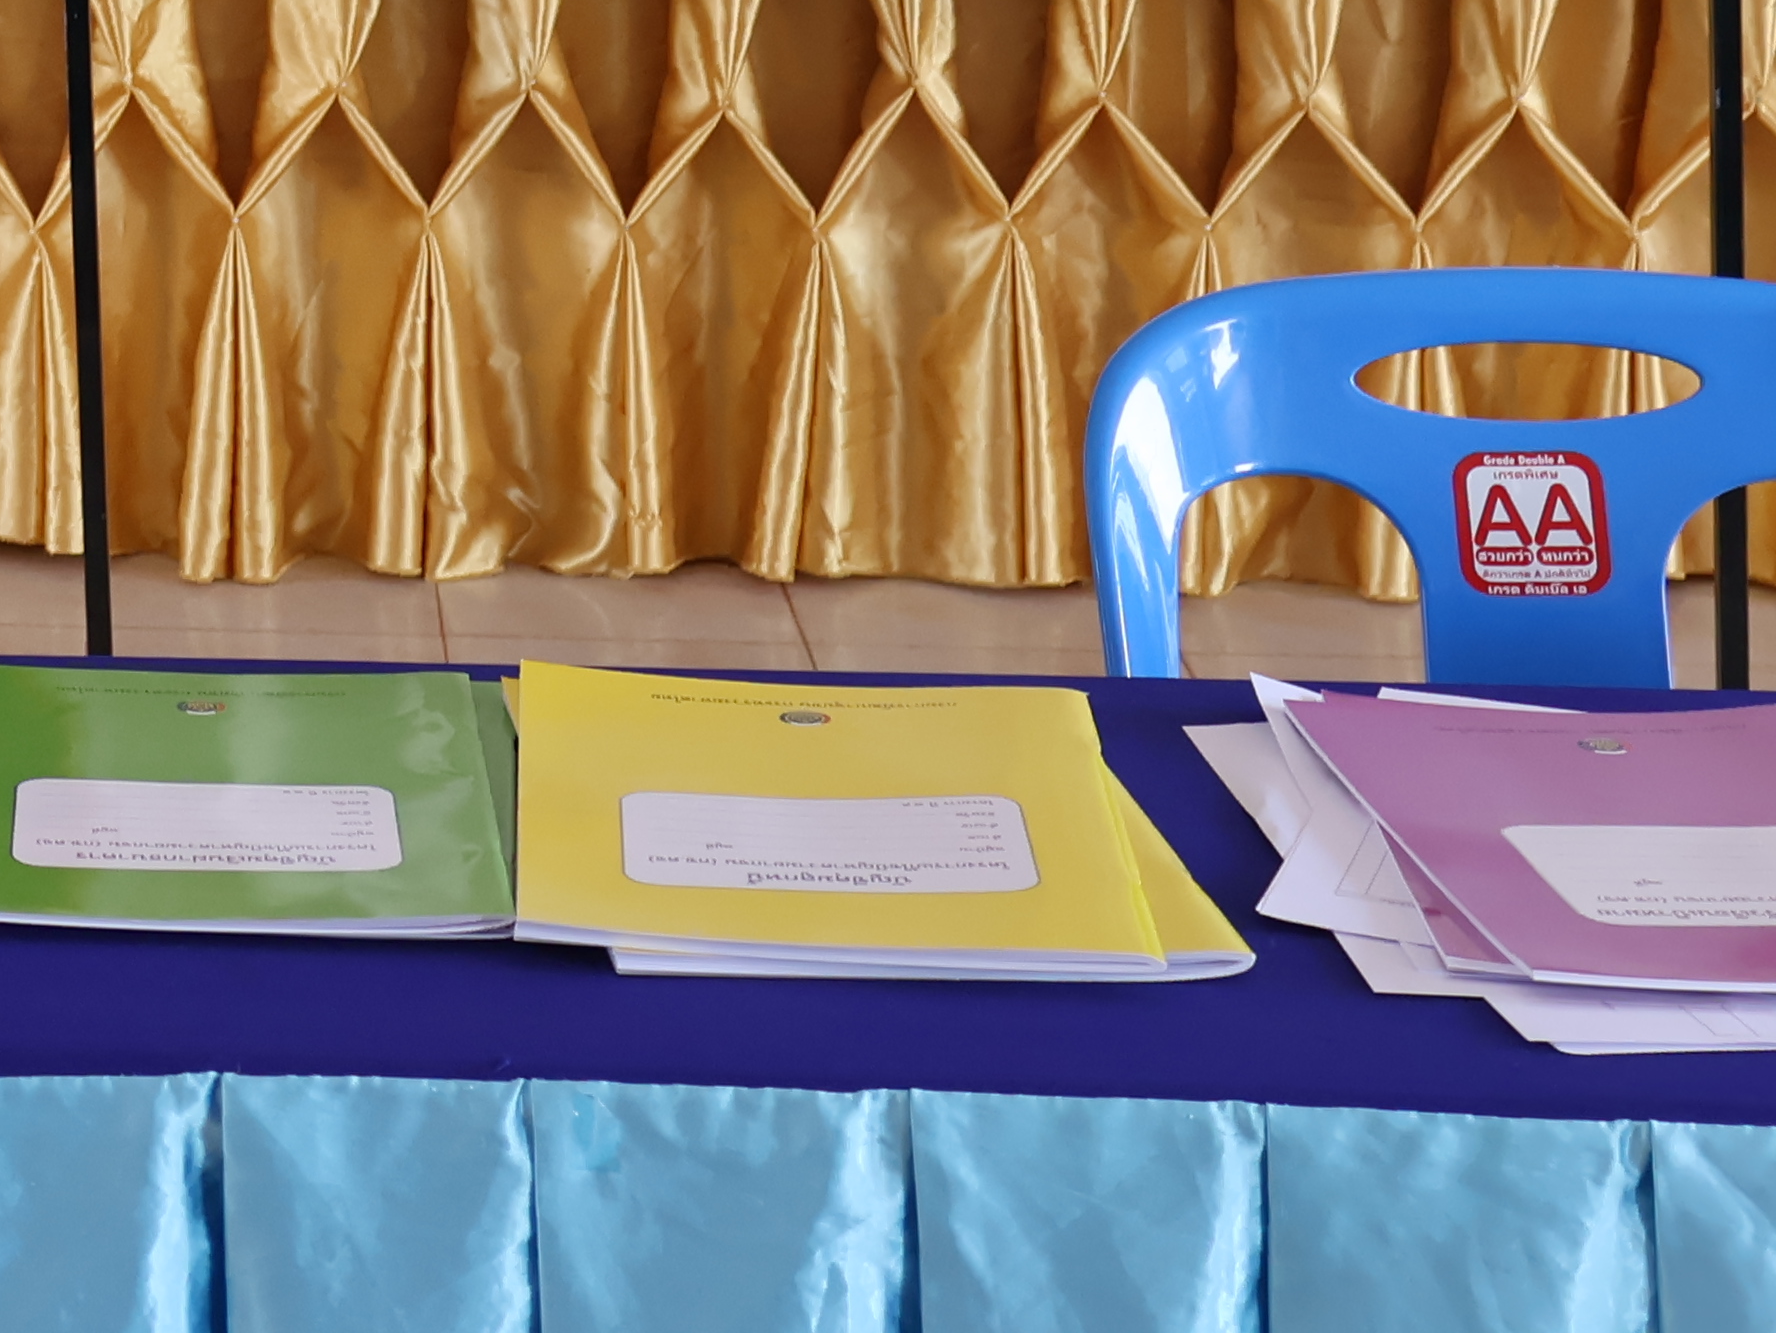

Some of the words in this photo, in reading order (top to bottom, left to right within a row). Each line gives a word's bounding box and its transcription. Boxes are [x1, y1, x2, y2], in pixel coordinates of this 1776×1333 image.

[1483, 454, 1515, 465] Grade
[1518, 454, 1554, 465] Double
[1557, 454, 1566, 465] A
[1492, 468, 1559, 480] เกรดพิเศษ
[1474, 483, 1594, 547] AA
[1478, 549, 1532, 562] สวยกว่า
[1541, 549, 1589, 562] ทนกว่า
